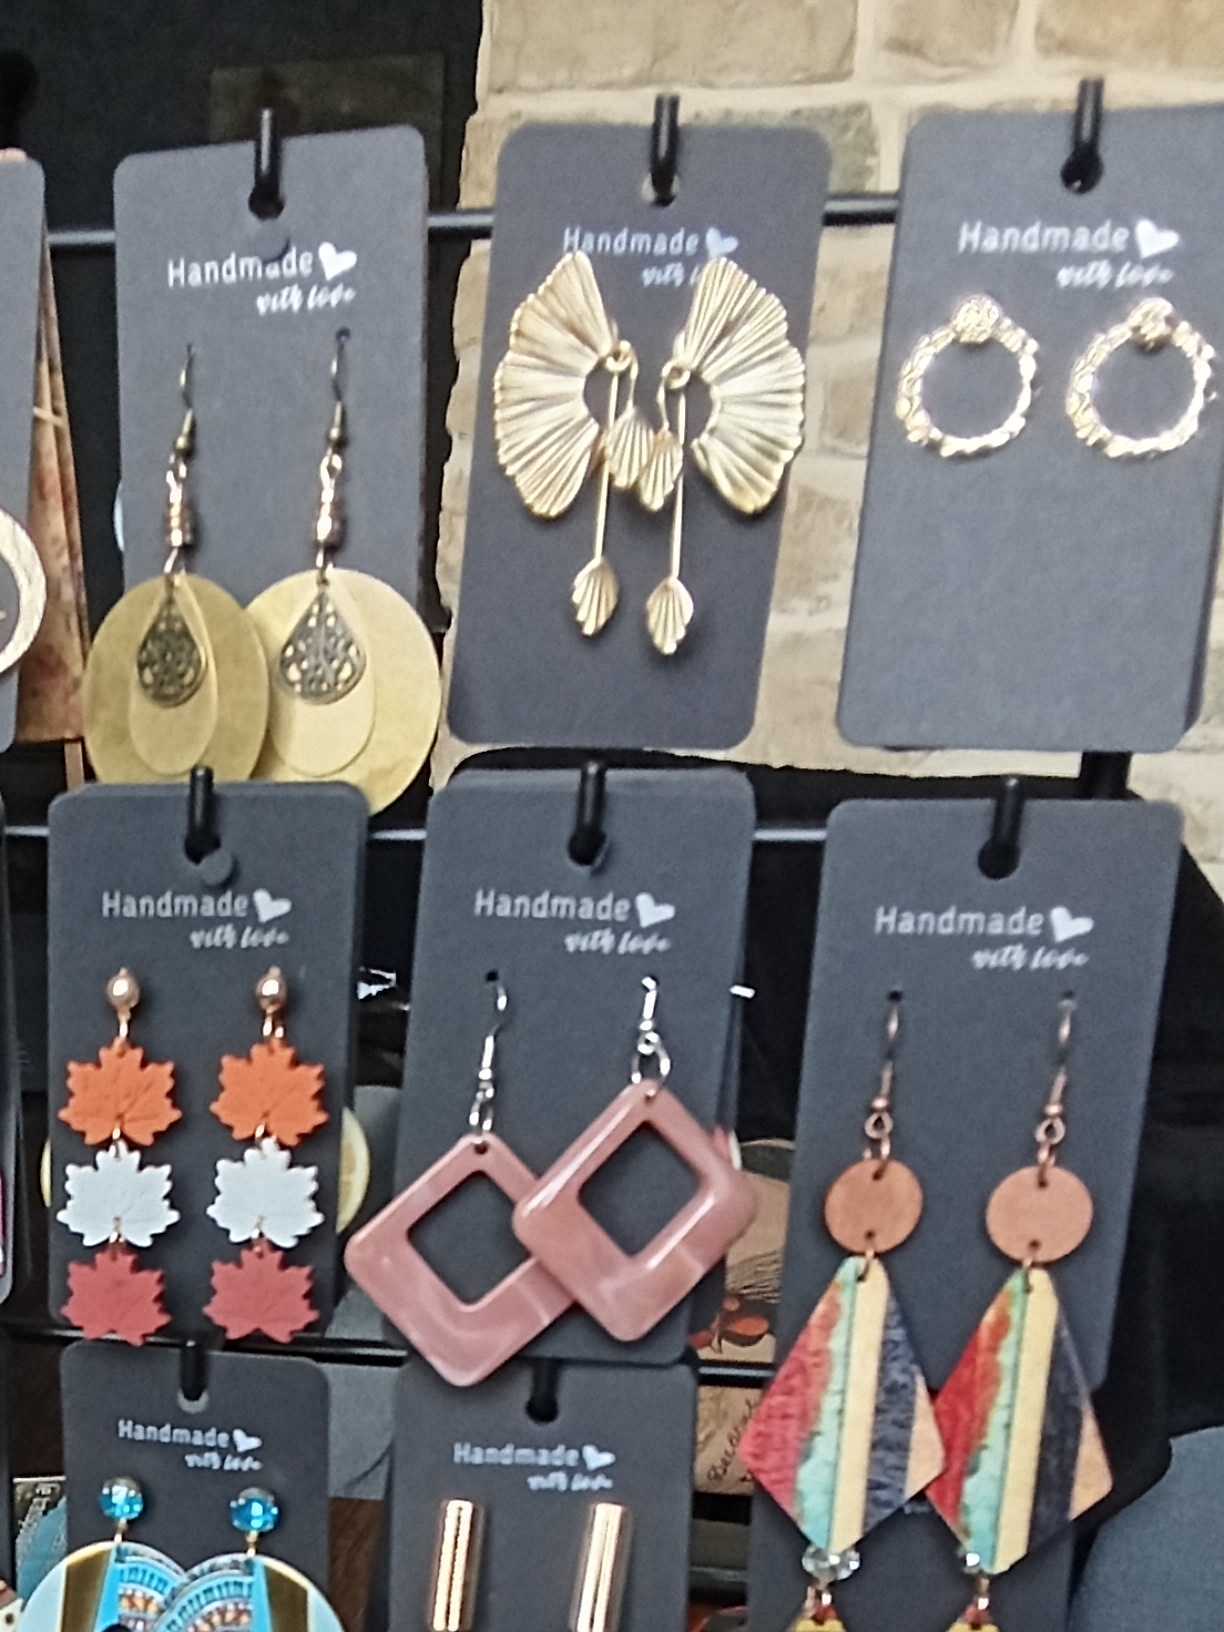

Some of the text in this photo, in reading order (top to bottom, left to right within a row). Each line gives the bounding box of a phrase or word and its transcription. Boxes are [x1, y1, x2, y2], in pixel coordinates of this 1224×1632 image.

[564, 227, 699, 254] Handmade
[958, 220, 1129, 253] Handmade
[168, 247, 313, 288] Handmade
[102, 890, 248, 917] Handmade
[474, 889, 631, 920] Handmade
[874, 906, 1044, 936] Handmade
[118, 1419, 230, 1448] Handmade
[453, 1443, 579, 1468] Handmade
